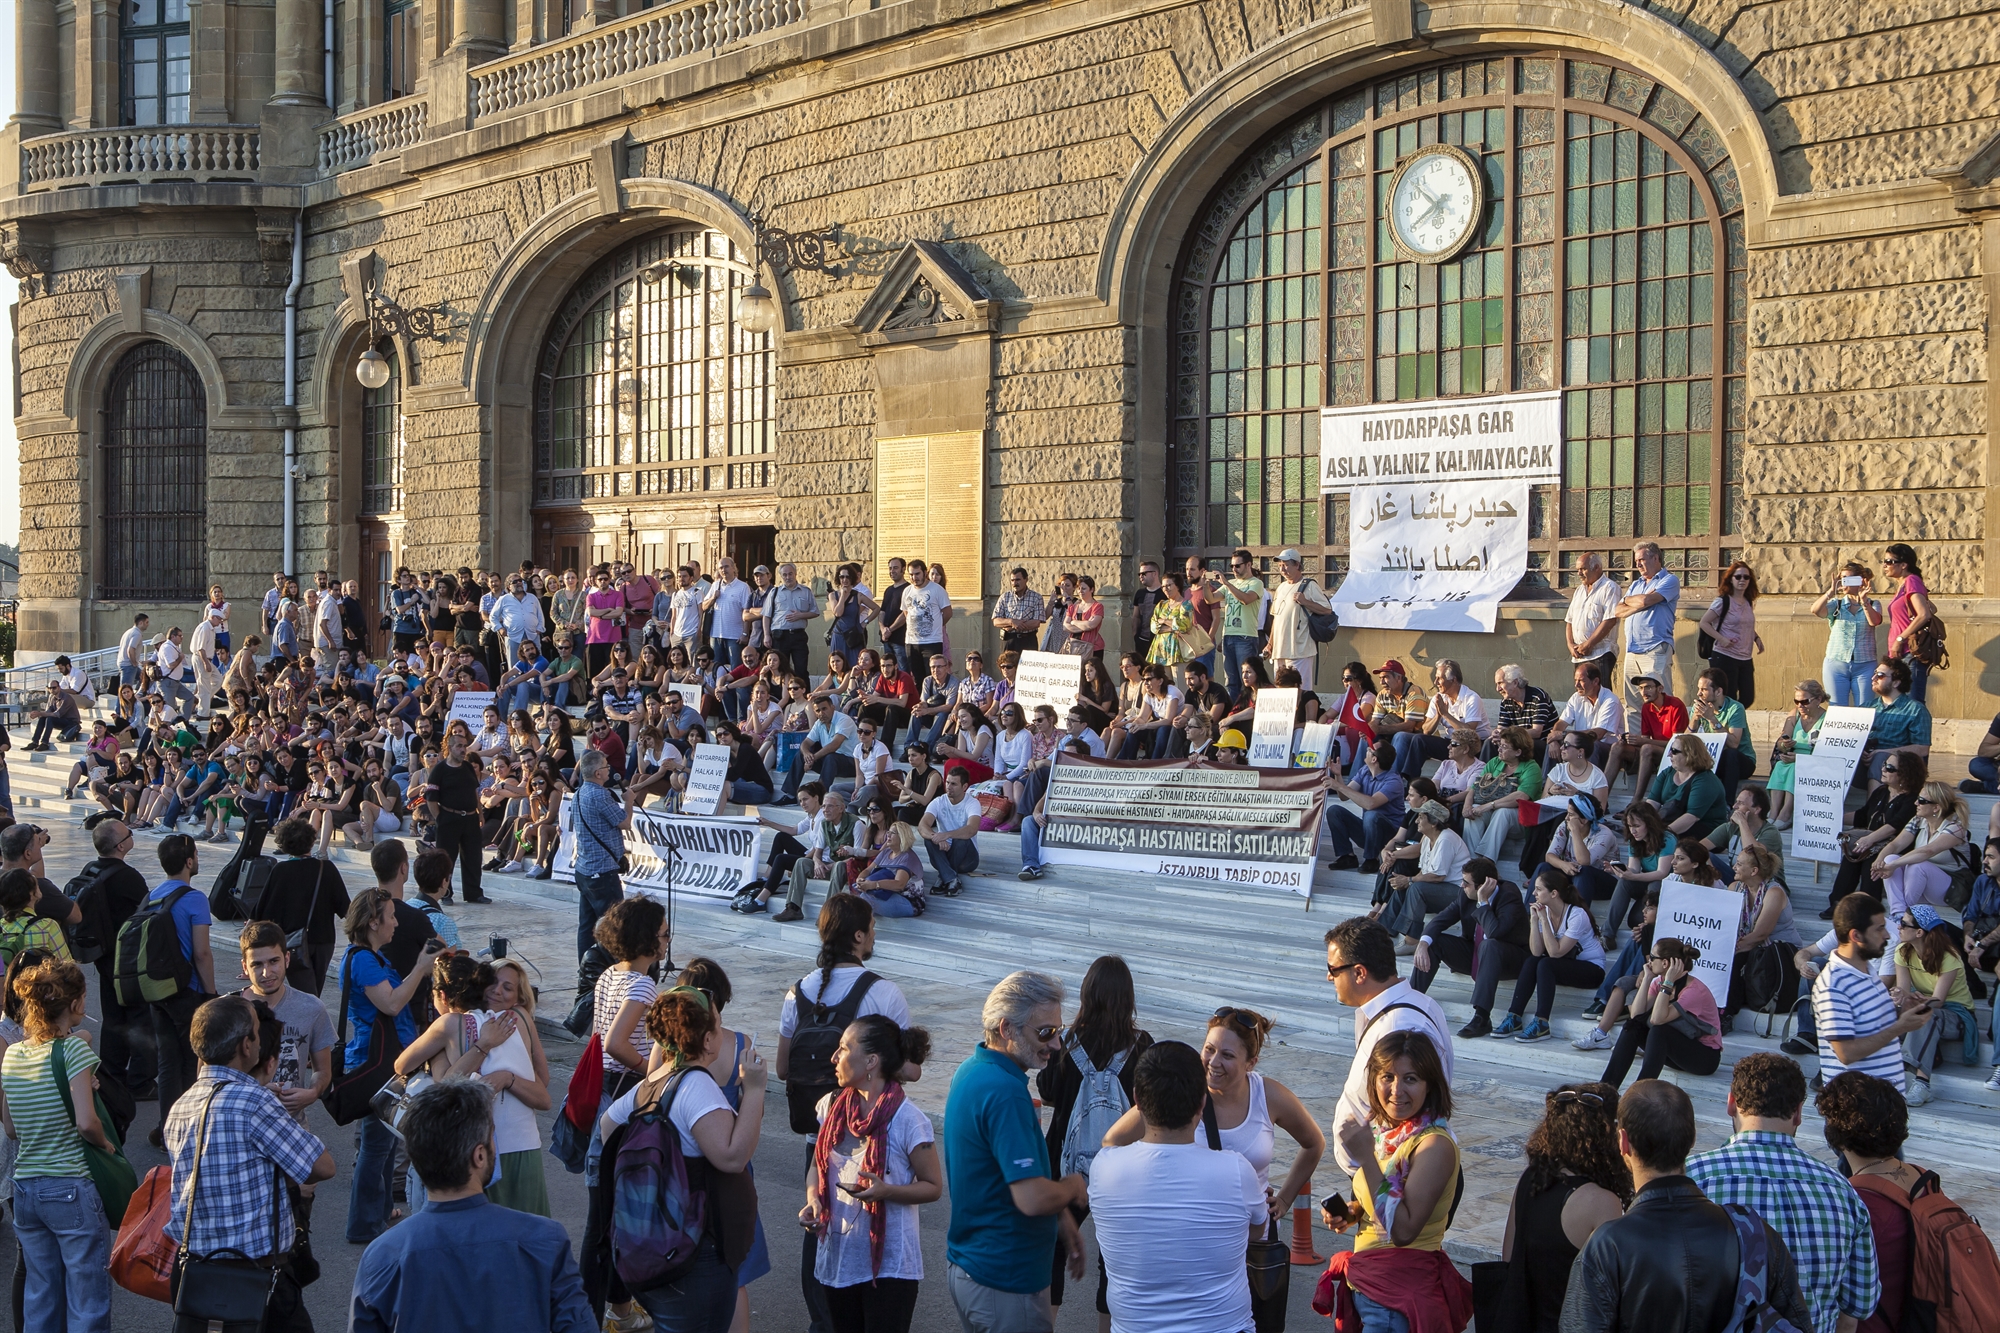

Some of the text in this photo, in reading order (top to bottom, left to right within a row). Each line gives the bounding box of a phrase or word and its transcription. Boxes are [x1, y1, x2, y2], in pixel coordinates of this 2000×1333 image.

[1429, 161, 1442, 174] 12
[1449, 166, 1456, 176] 1
[1457, 175, 1465, 187] 2
[1409, 191, 1421, 202] 10
[1462, 195, 1470, 205] 3
[1405, 206, 1413, 217] 9
[1458, 215, 1466, 225] 4
[1410, 222, 1418, 234] 8
[1449, 228, 1457, 239] 5
[1419, 234, 1426, 245] 7
[1435, 235, 1443, 245] 6
[1362, 410, 1514, 442] HAYDARPAŞA GAR
[1326, 444, 1554, 479] ASLA YALNIZ KALMAYACAK
[1359, 492, 1399, 531] غار
[1020, 675, 1037, 683] HALKA
[1048, 678, 1078, 688] GAR ASLA
[1018, 690, 1046, 699] TRENLERE
[1051, 696, 1071, 705] YALNIZ
[1258, 698, 1293, 717] HAYDARPAŞA
[1258, 721, 1288, 736] HALKINDIR
[1824, 720, 1869, 732] HAYDARPAŞA
[1825, 737, 1858, 749] TRENSİZ
[1254, 744, 1285, 759] SATILAMAZ
[696, 754, 728, 763] HAYDARPAŞA
[715, 769, 723, 777] VE
[1055, 768, 1258, 786] MARMARA ÜNİVERSİTESİ TIP FAKÜLTESİ (TARİHİ TIBBİYE BİNASI)
[691, 782, 720, 791] TRENLERE
[1798, 777, 1842, 790] HAYDARPAŞA
[1053, 786, 1311, 806] GATA HAYDARPAŞA YERLEŞKESİ SİYAMİ ERSEK EĞİTİM ARAŞTIRMA HASTANESİ
[1806, 794, 1832, 805] TRENSİZ,
[1050, 802, 1291, 823] HAYDARPAŞA NUMUNE HASTANESİ HAYDARPAŞA SAĞLIK MESLEK LİSESİ
[1802, 809, 1835, 821] VAPURSUZ,
[1804, 822, 1831, 835] İNSANSIZ
[636, 819, 754, 857] KALDIRILIYOR
[1045, 823, 1313, 857] HAYDARPAŞA HASTANELERİ SATILAMAZ!
[1797, 839, 1837, 851] KALMAYACAK
[658, 859, 743, 892] YOLCULAR
[1158, 861, 1301, 886] İSTANBUL TABİP ODASI
[1673, 912, 1722, 930] ULAŞIM
[1677, 935, 1712, 950] HAKKI
